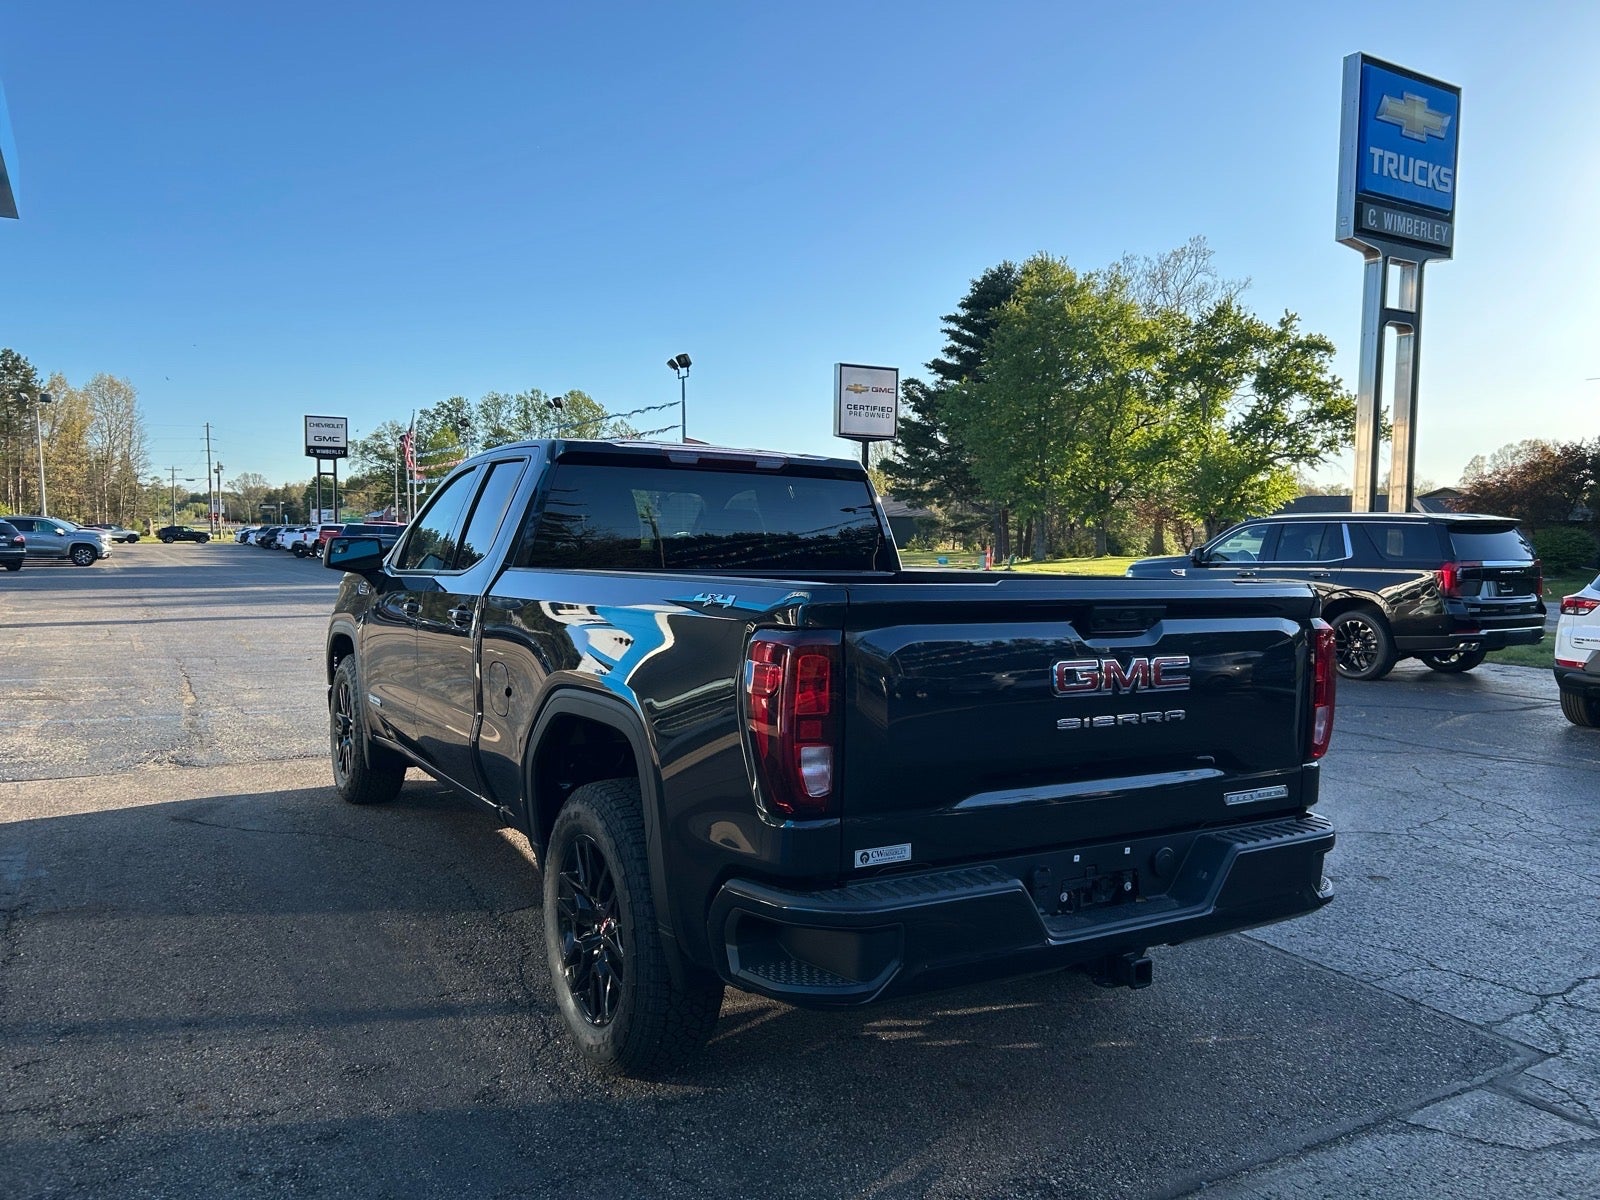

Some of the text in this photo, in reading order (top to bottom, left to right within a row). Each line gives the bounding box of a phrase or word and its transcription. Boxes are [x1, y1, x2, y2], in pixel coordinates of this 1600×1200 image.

[1369, 146, 1453, 193] TRUCKS
[1383, 211, 1449, 242] WIMBERLEY
[871, 386, 895, 394] GMC
[846, 403, 893, 413] CERTIFIED
[313, 435, 341, 443] GMC
[1053, 656, 1191, 697] GMC
[1056, 709, 1186, 730] SIERRA
